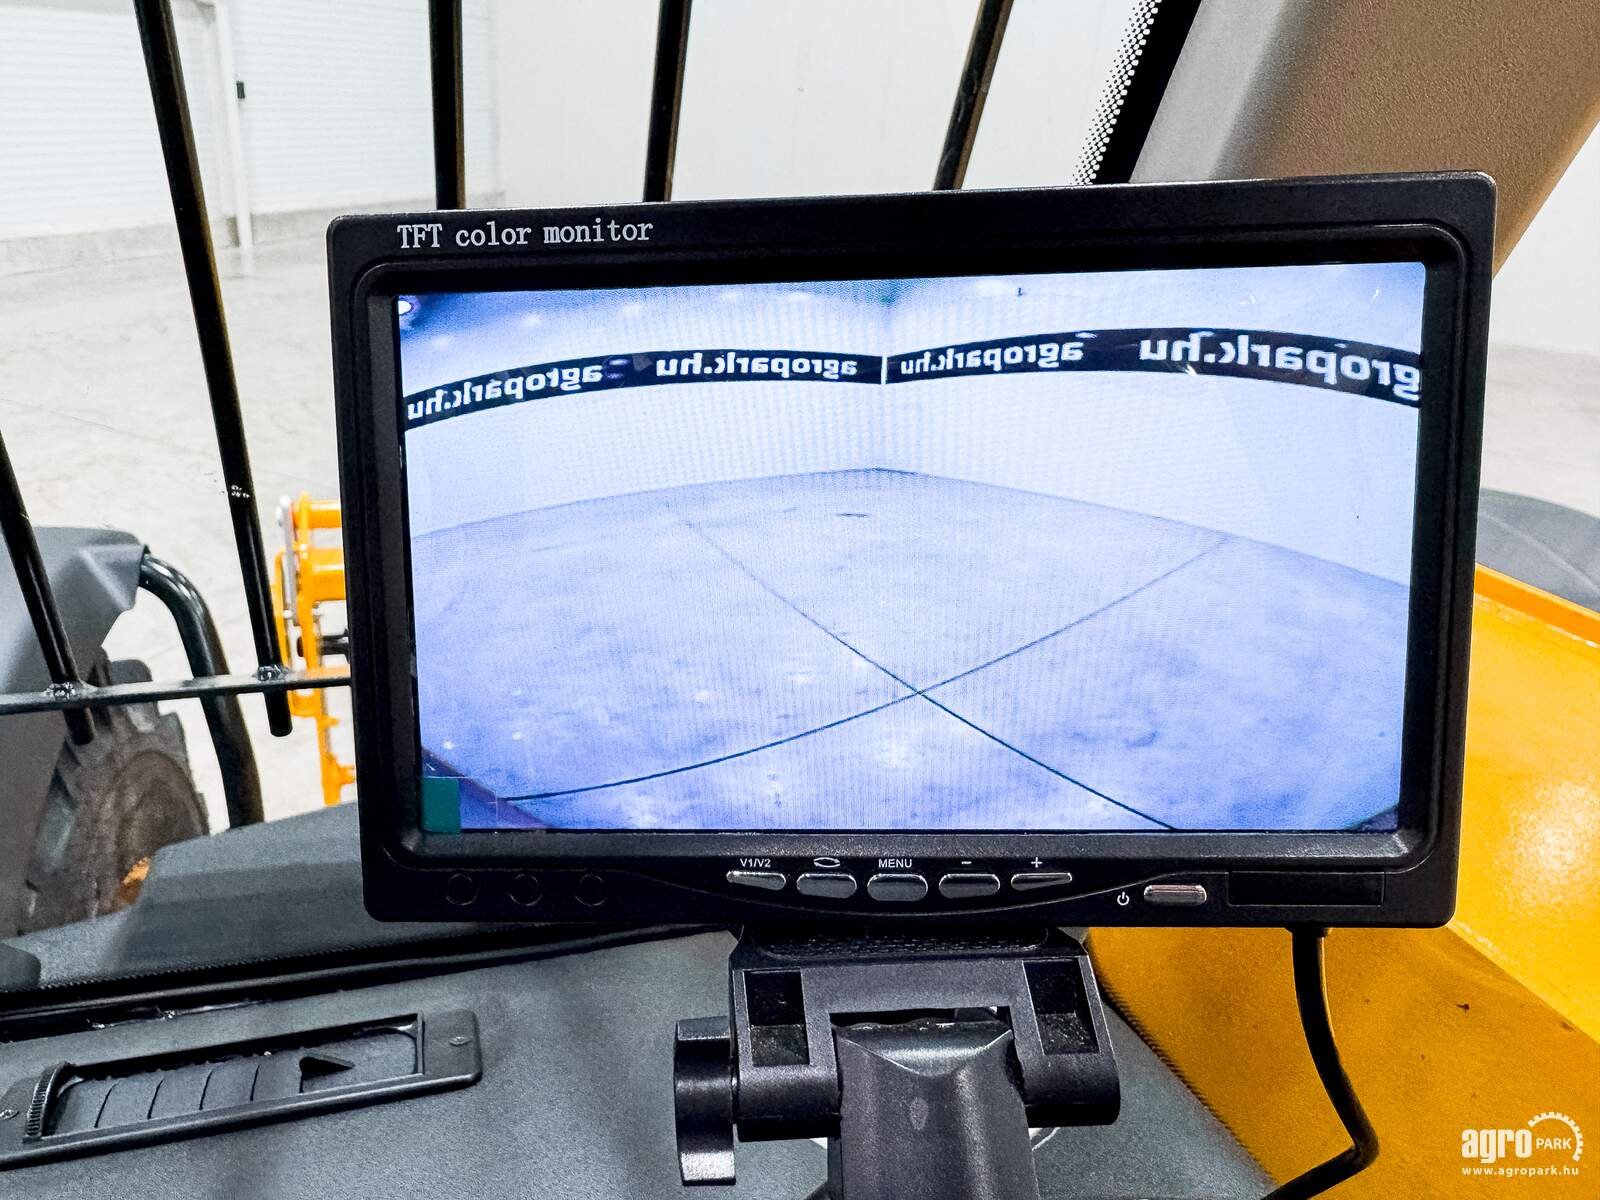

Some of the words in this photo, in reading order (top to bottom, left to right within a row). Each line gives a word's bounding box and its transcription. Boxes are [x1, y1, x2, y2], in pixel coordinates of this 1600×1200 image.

[397, 223, 443, 249] TFT
[455, 220, 532, 247] color
[543, 217, 653, 244] monitor
[739, 858, 771, 868] V1/V2
[878, 859, 913, 868] MENU
